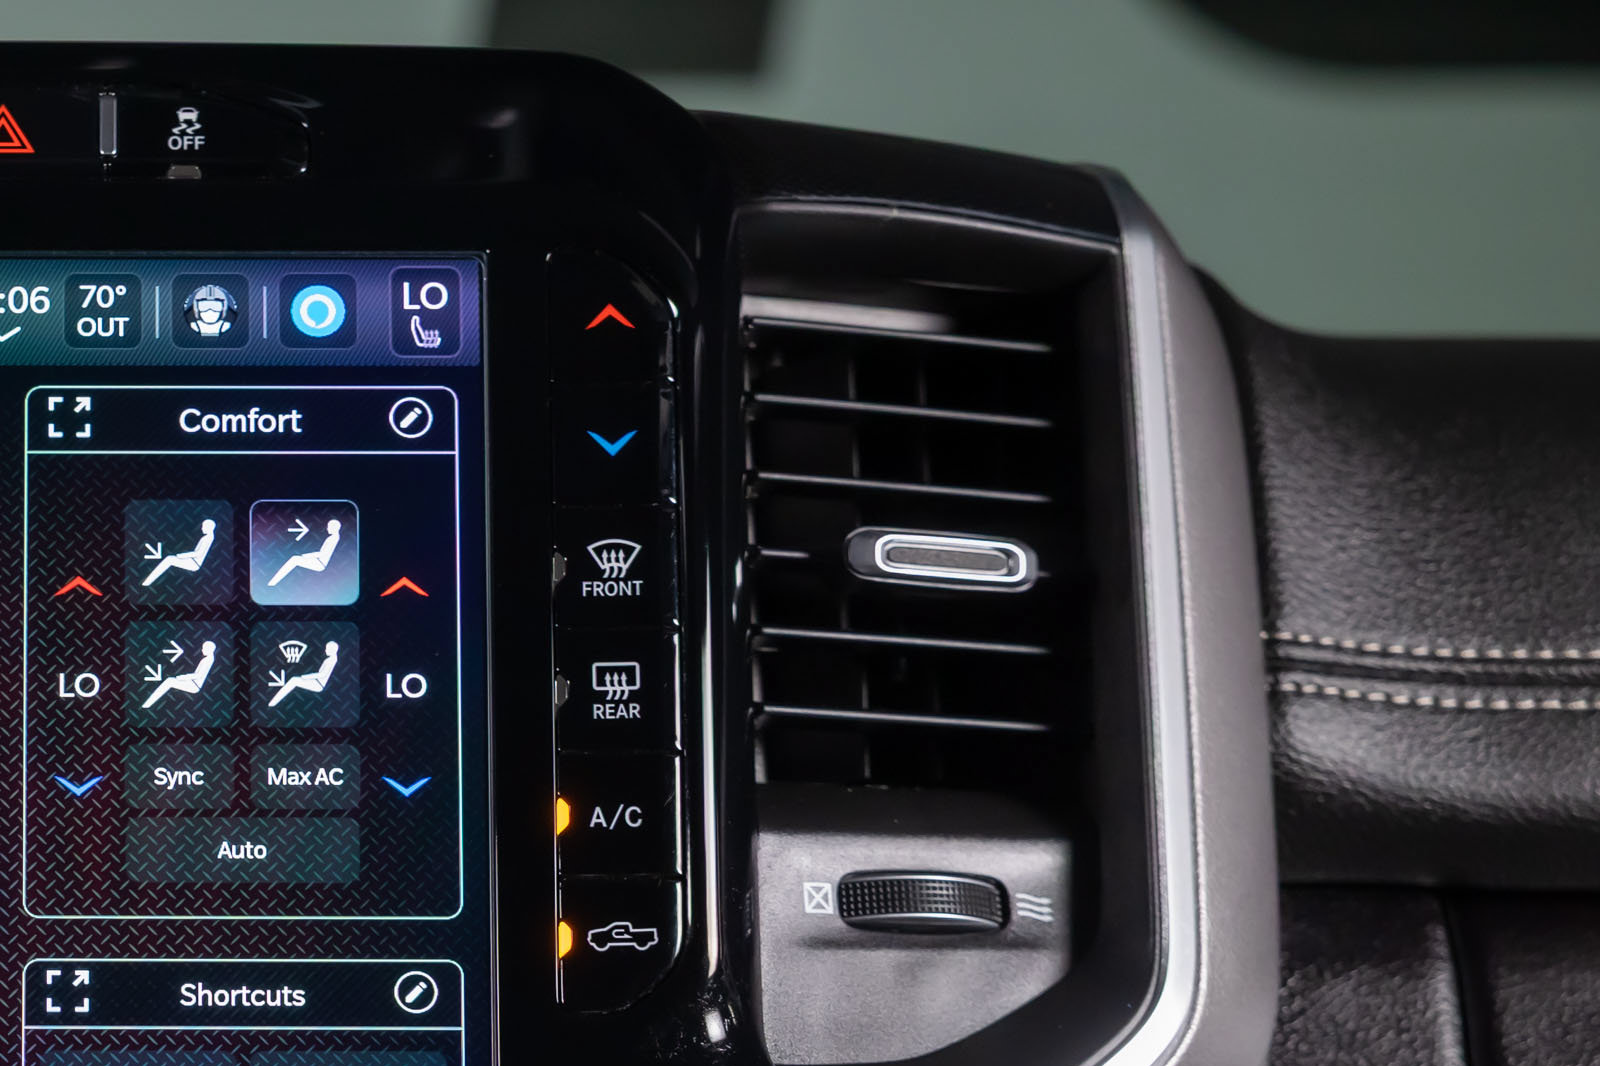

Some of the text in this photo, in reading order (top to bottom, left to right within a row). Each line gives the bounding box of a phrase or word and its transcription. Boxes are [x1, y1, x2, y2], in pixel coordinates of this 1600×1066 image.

[167, 135, 205, 151] OFF
[78, 284, 127, 309] 70°
[403, 281, 449, 310] LO
[76, 316, 130, 337] OUT
[178, 407, 302, 433] Comfort
[582, 580, 644, 597] FRONT
[58, 672, 100, 698] LO
[386, 673, 427, 699] LO
[593, 702, 641, 720] REAR
[153, 767, 205, 790] Sync
[267, 767, 344, 786] Max AC
[589, 803, 643, 830] A/C
[217, 841, 267, 860] Auto
[179, 981, 306, 1007] Shortcuts
